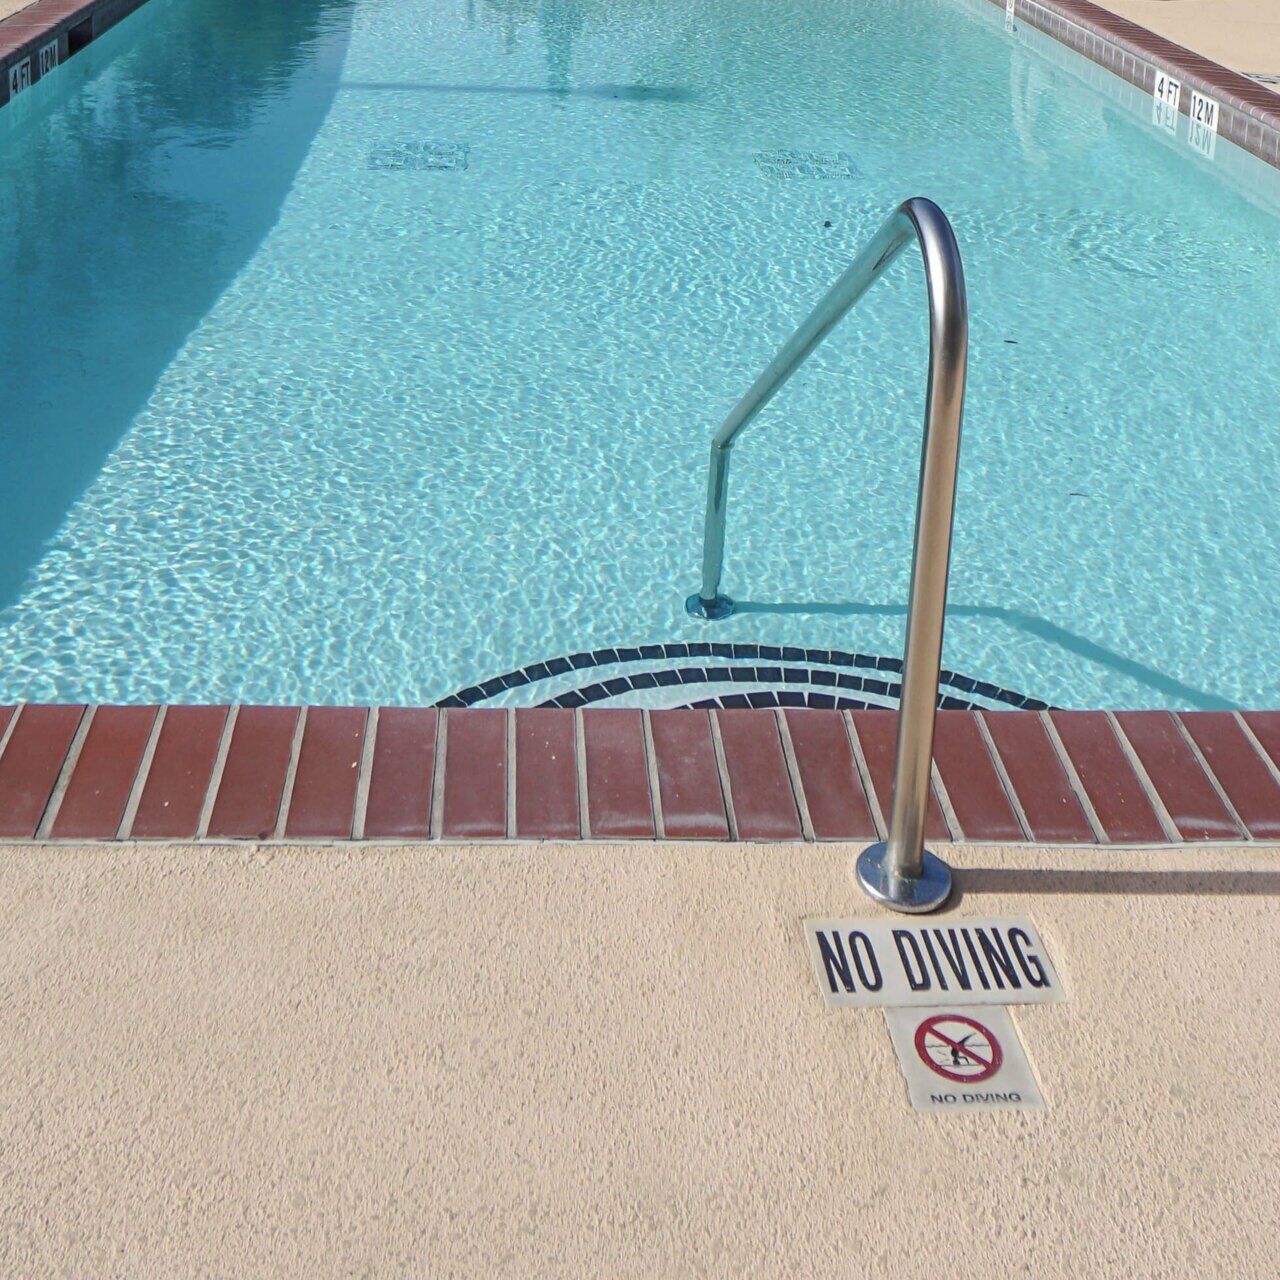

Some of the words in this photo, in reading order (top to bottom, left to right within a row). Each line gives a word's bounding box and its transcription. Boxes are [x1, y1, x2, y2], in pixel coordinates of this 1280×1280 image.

[12, 69, 18, 94] 4
[21, 61, 30, 90] FT
[1157, 77, 1165, 99] 4
[1166, 81, 1179, 106] FT
[815, 930, 884, 994] NO
[891, 927, 1052, 992] DIVING
[930, 1094, 958, 1104] NO
[962, 1092, 1023, 1104] DIVING
